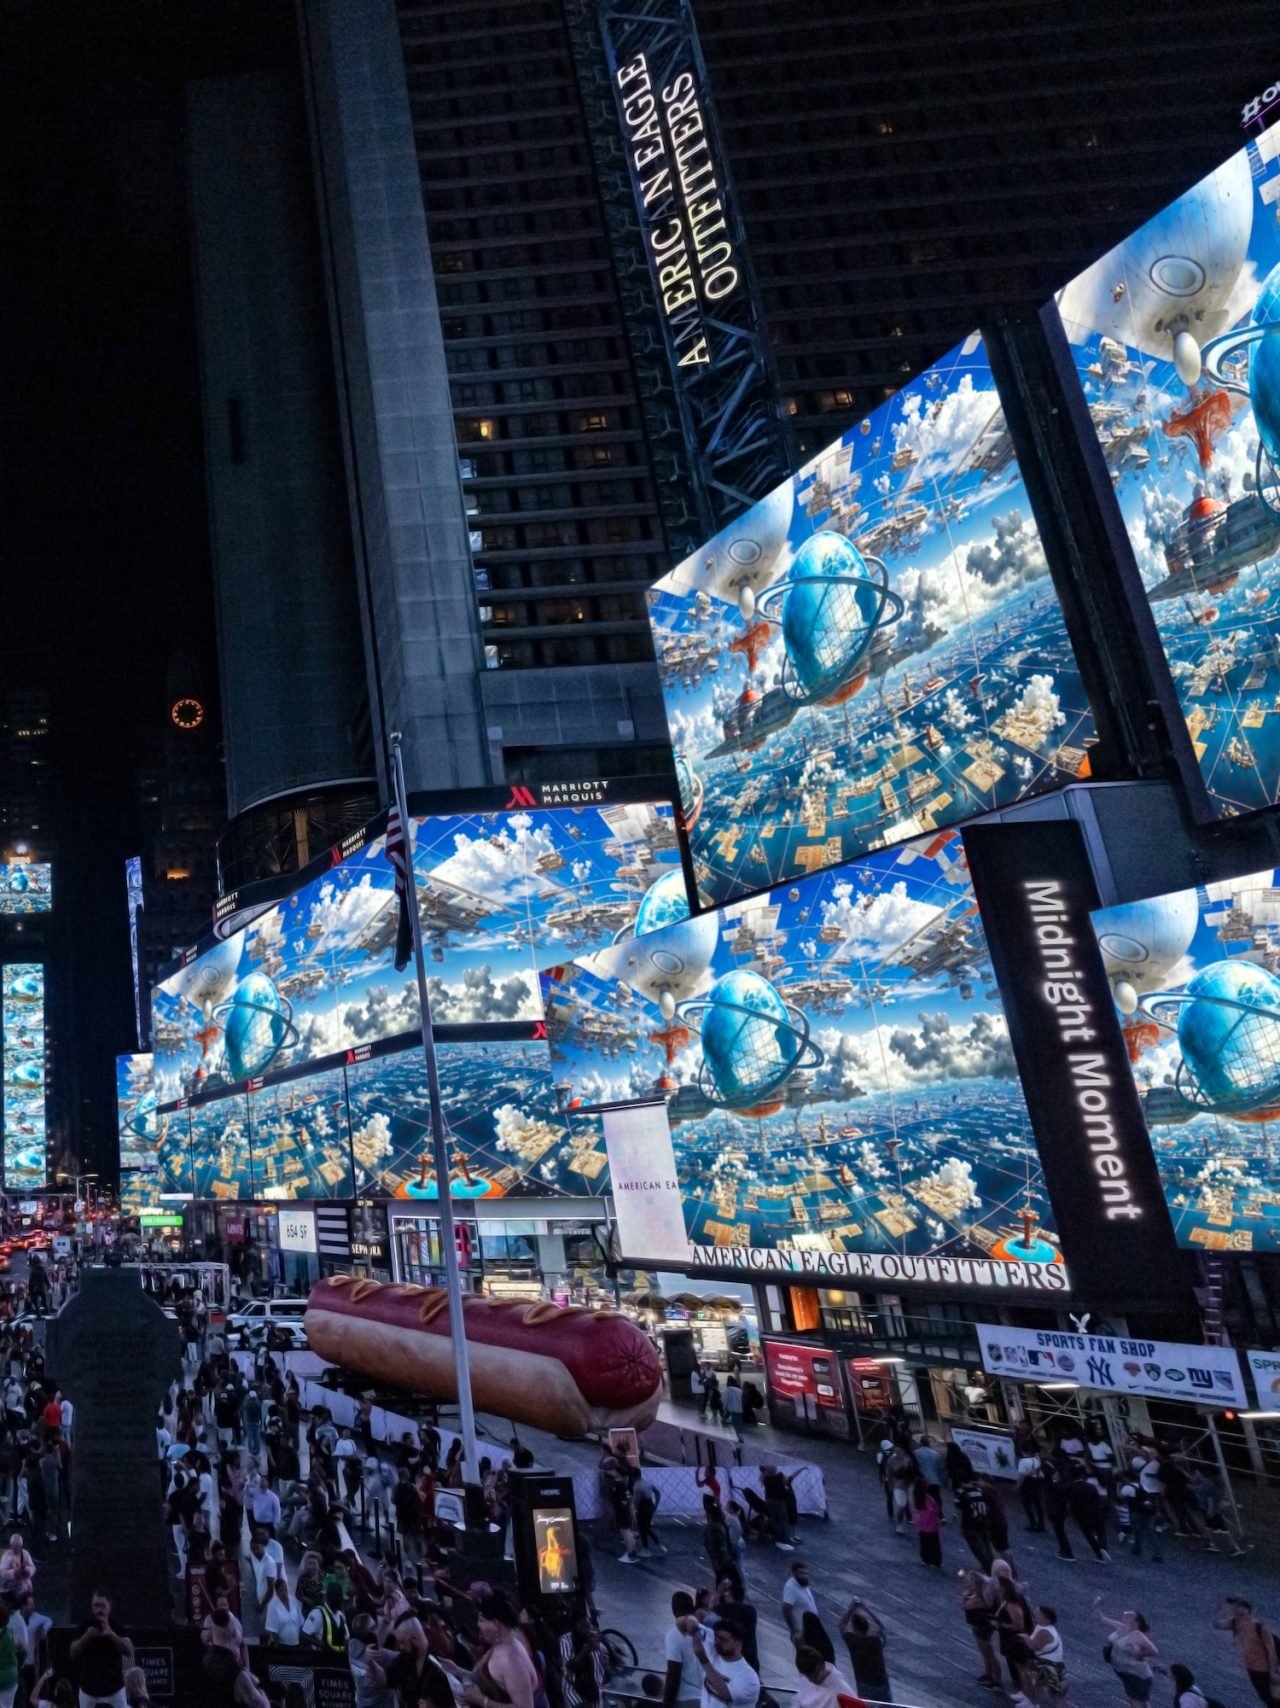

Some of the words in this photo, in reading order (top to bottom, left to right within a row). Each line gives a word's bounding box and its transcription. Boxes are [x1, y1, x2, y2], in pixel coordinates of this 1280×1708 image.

[617, 53, 664, 172] EAGLE
[662, 73, 737, 300] OUTFITTERS
[640, 168, 710, 367] AMERICAN
[541, 781, 608, 793] MARRIOTT
[543, 792, 602, 804] MARQUIS
[1024, 880, 1096, 1042] Midnight
[1066, 1053, 1143, 1220] Moment
[618, 1181, 662, 1191] AMERICAN
[691, 1245, 795, 1272] AMERICAN
[800, 1250, 875, 1278] EAGLE
[880, 1255, 1066, 1290] OUTFITTERS
[1037, 1332, 1086, 1351] SPORTS
[1089, 1338, 1116, 1355] FAN
[1120, 1341, 1156, 1357] SHOP
[141, 1658, 166, 1667] TIMES
[320, 1679, 350, 1690] TIMES
